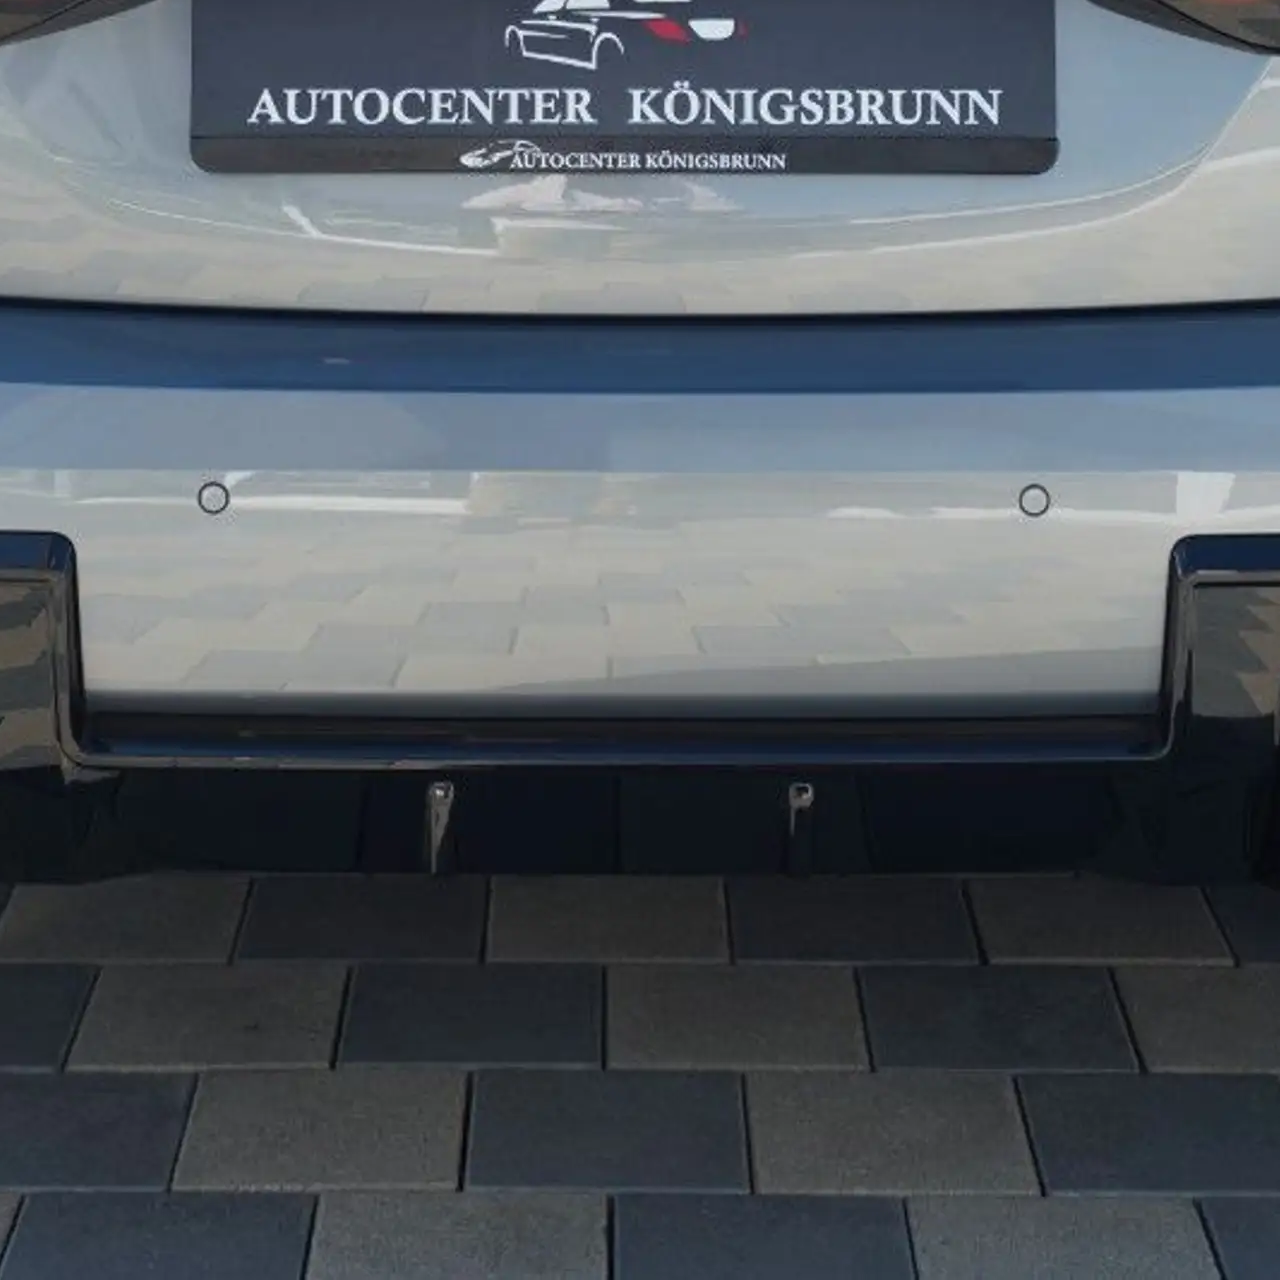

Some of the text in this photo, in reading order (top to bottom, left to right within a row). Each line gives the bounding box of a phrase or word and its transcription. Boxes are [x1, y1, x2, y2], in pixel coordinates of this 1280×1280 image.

[246, 80, 1004, 126] AUTOCENTER KÖNIGSBRUNN
[510, 150, 788, 170] AUTOCENTER KÖNIGSBRUNN
